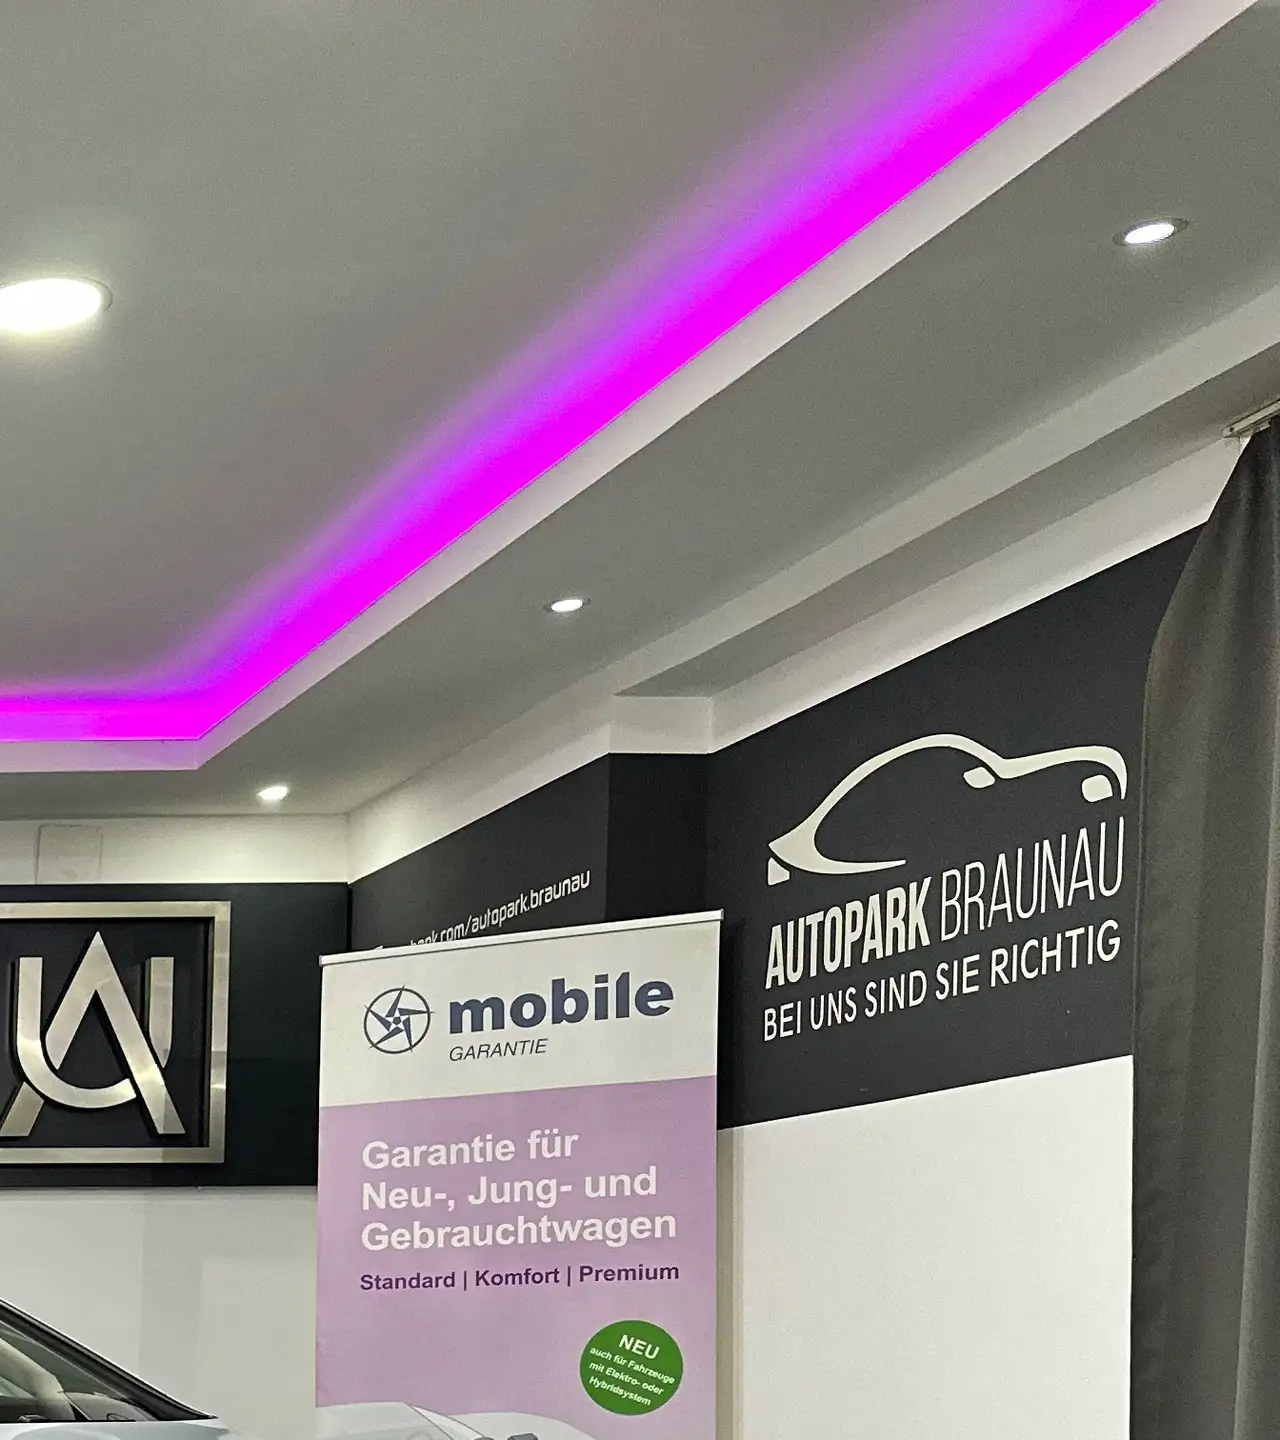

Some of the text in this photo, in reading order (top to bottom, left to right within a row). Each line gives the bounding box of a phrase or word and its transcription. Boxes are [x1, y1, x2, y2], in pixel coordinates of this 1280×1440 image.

[766, 817, 1124, 989] AUTOPARK BRAUNAU
[765, 920, 1121, 1041] BEI UNS SIND SIE RICHTIG
[450, 972, 674, 1034] mobile
[449, 1038, 548, 1061] GARANTIE
[362, 1129, 579, 1169] Garantie für
[362, 1166, 657, 1211] Neu-, Jung- und
[361, 1215, 676, 1250] Gebrauchtwagen
[360, 1272, 456, 1291] Standard
[475, 1267, 560, 1287] Komfort
[579, 1264, 679, 1283] Premium
[618, 1334, 660, 1359] NEU
[589, 1347, 675, 1384] auch für Fahrzeuge
[589, 1362, 604, 1373] mit
[641, 1382, 664, 1395] oder
[589, 1376, 651, 1405] Hybridsystem
